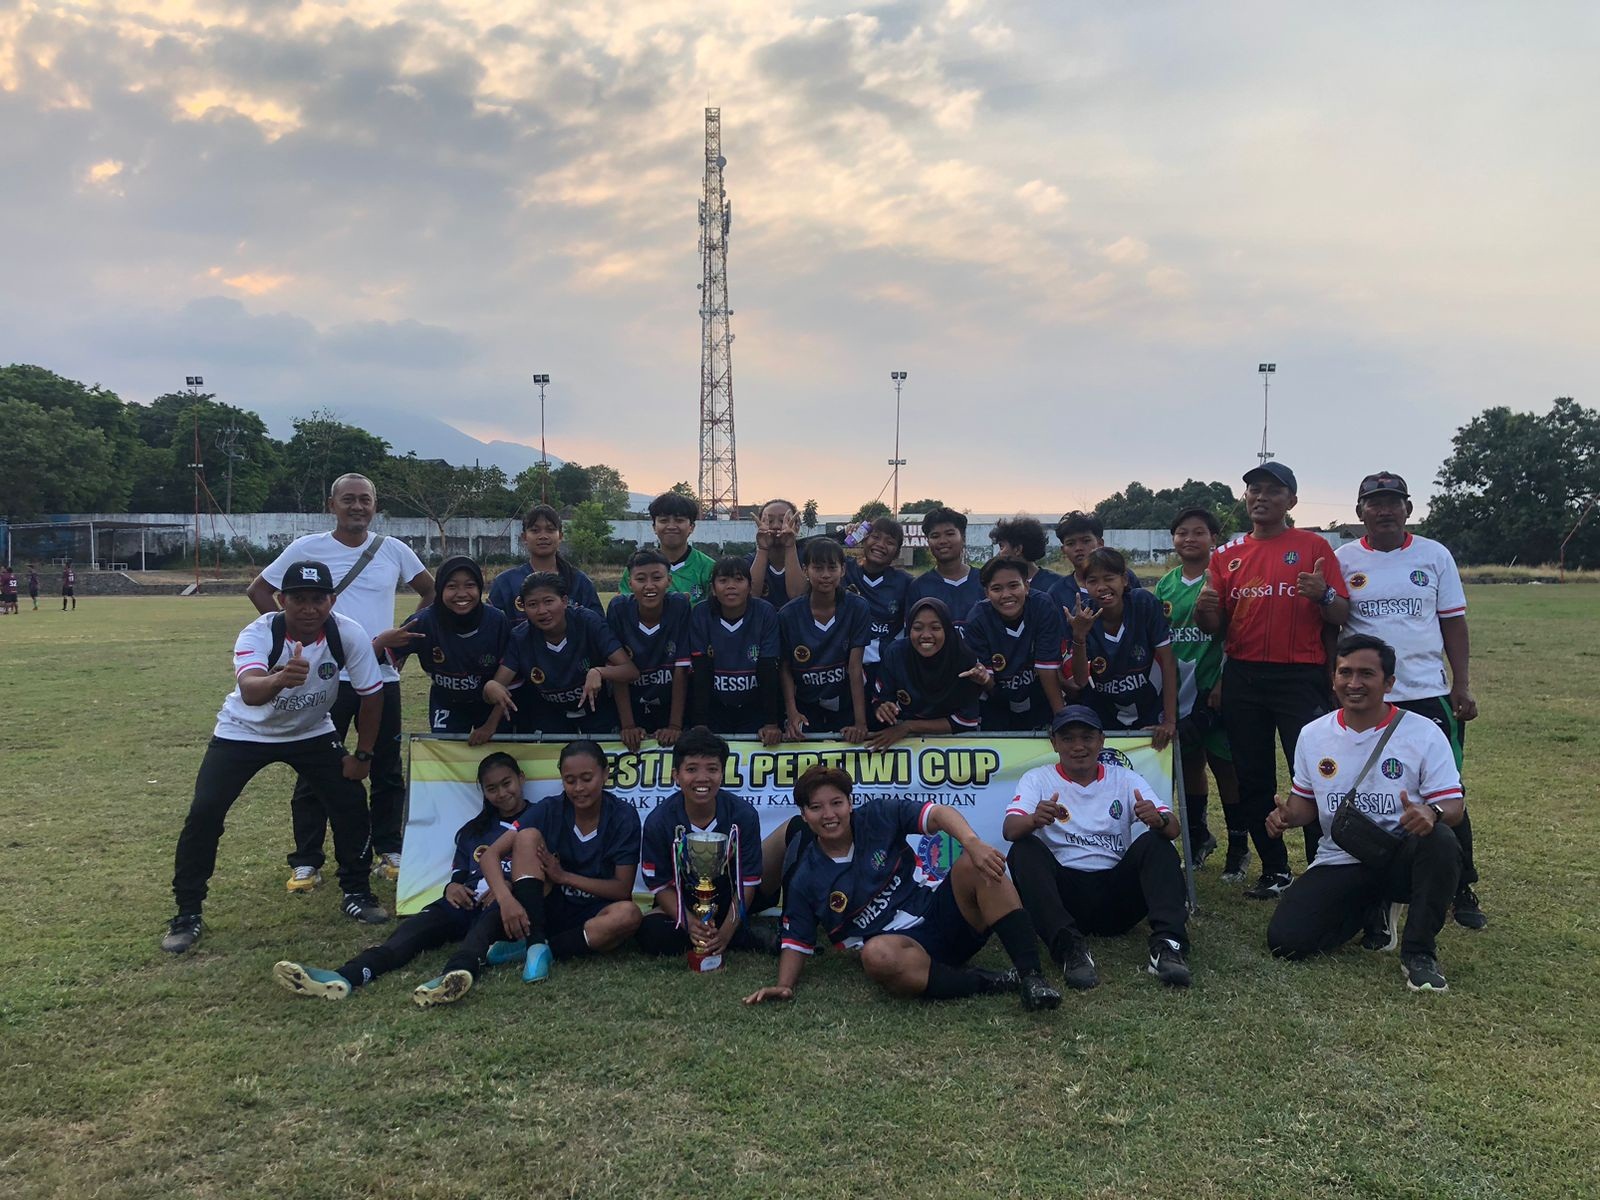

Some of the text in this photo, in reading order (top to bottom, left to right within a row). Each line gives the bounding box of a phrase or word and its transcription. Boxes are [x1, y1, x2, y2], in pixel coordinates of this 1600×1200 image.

[1279, 582, 1296, 597] Fc
[1358, 598, 1423, 617] GRESSIA
[713, 675, 759, 691] RESSIA
[802, 667, 846, 685] GRESSI
[1096, 673, 1147, 694] GRESSIA
[433, 709, 450, 729] 12
[603, 750, 744, 789] ESTIL
[919, 749, 999, 787] CUP
